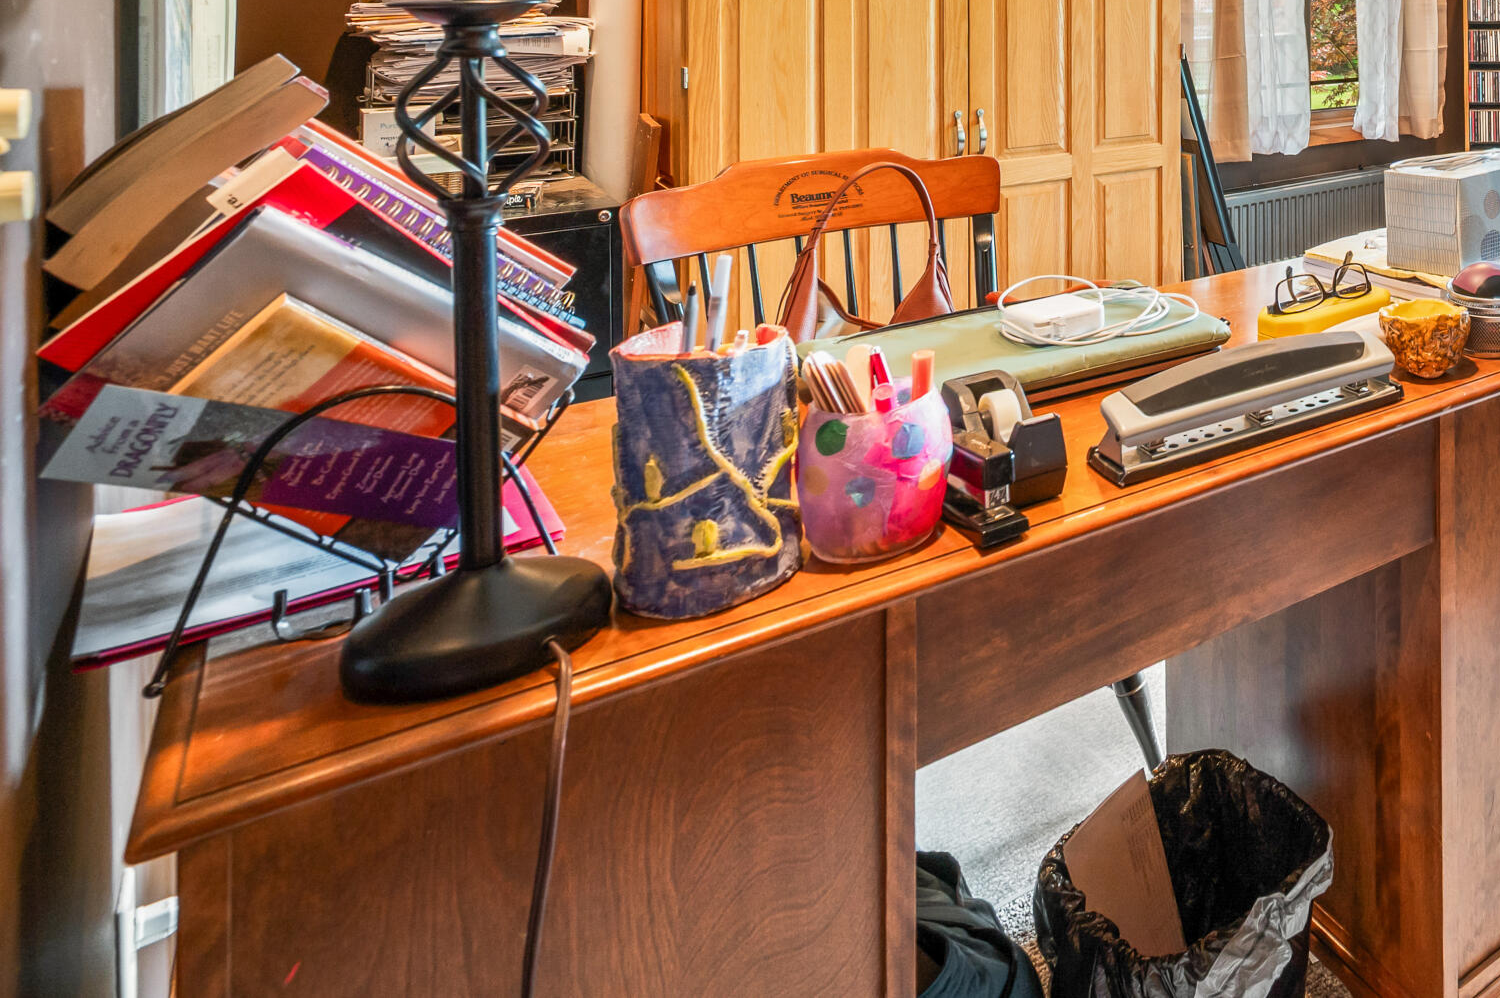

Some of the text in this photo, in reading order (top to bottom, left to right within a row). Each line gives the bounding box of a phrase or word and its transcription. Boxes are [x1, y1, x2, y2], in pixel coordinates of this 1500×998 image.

[347, 163, 371, 181] LOVE
[371, 176, 425, 215] LANGUAGES
[86, 416, 121, 453] Advice
[109, 402, 179, 478] DRAGONFLY
